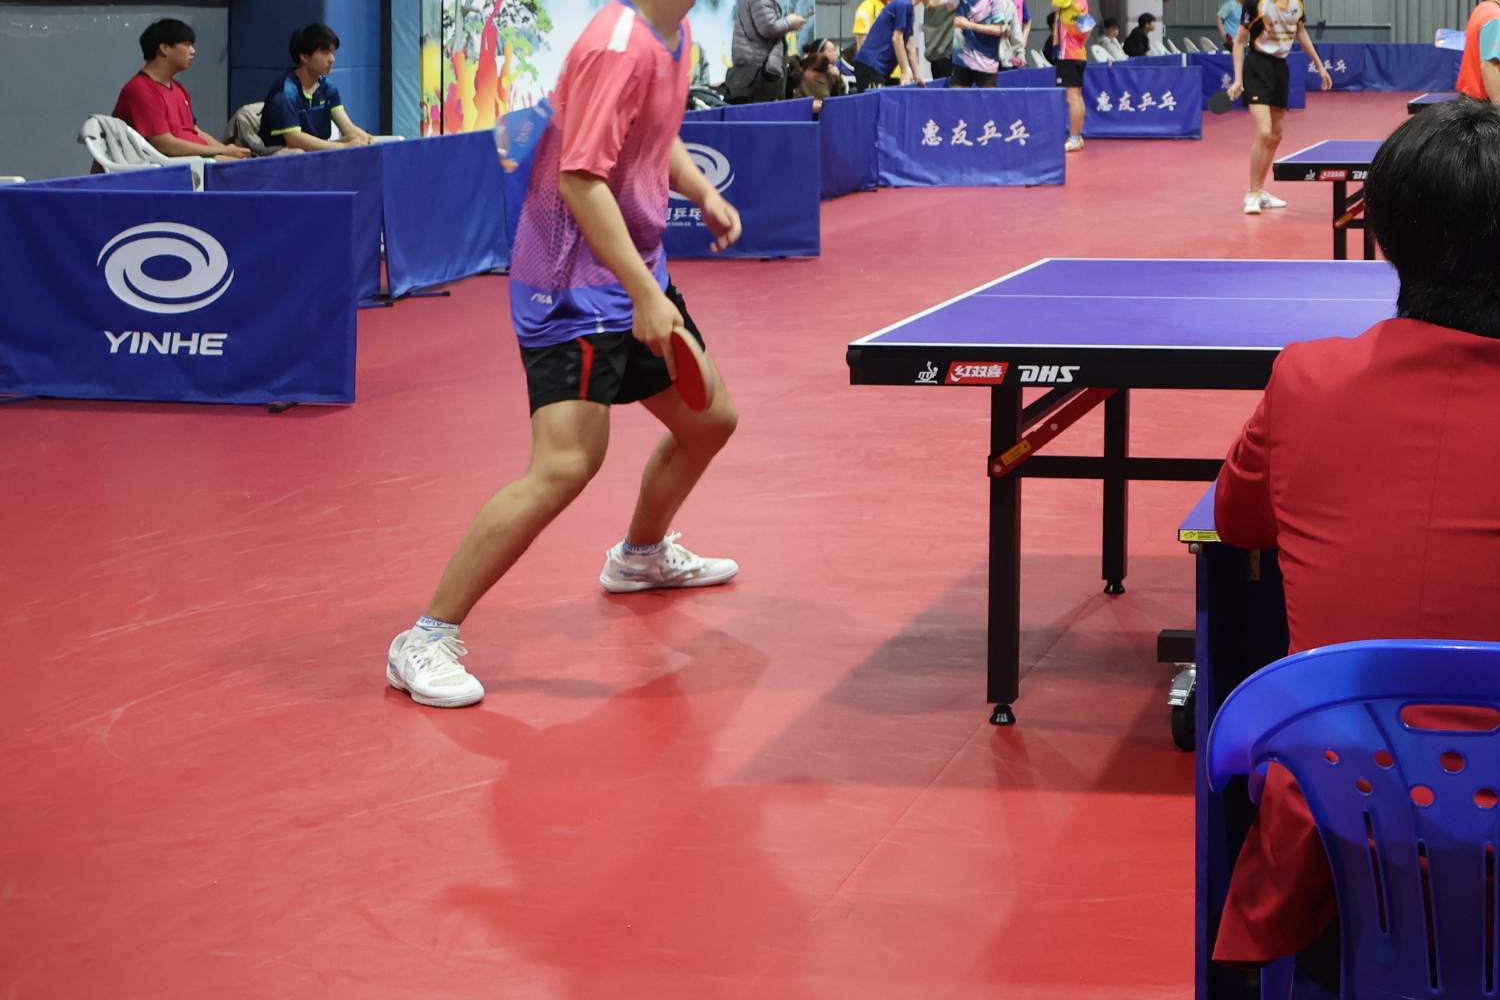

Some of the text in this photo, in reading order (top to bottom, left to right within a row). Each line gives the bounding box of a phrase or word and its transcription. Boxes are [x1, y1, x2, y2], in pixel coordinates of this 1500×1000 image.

[1096, 90, 1177, 112] 惠友乒乓
[921, 119, 1030, 146] 惠友乒乓
[103, 330, 229, 356] YINHE
[1018, 364, 1080, 383] DHS
